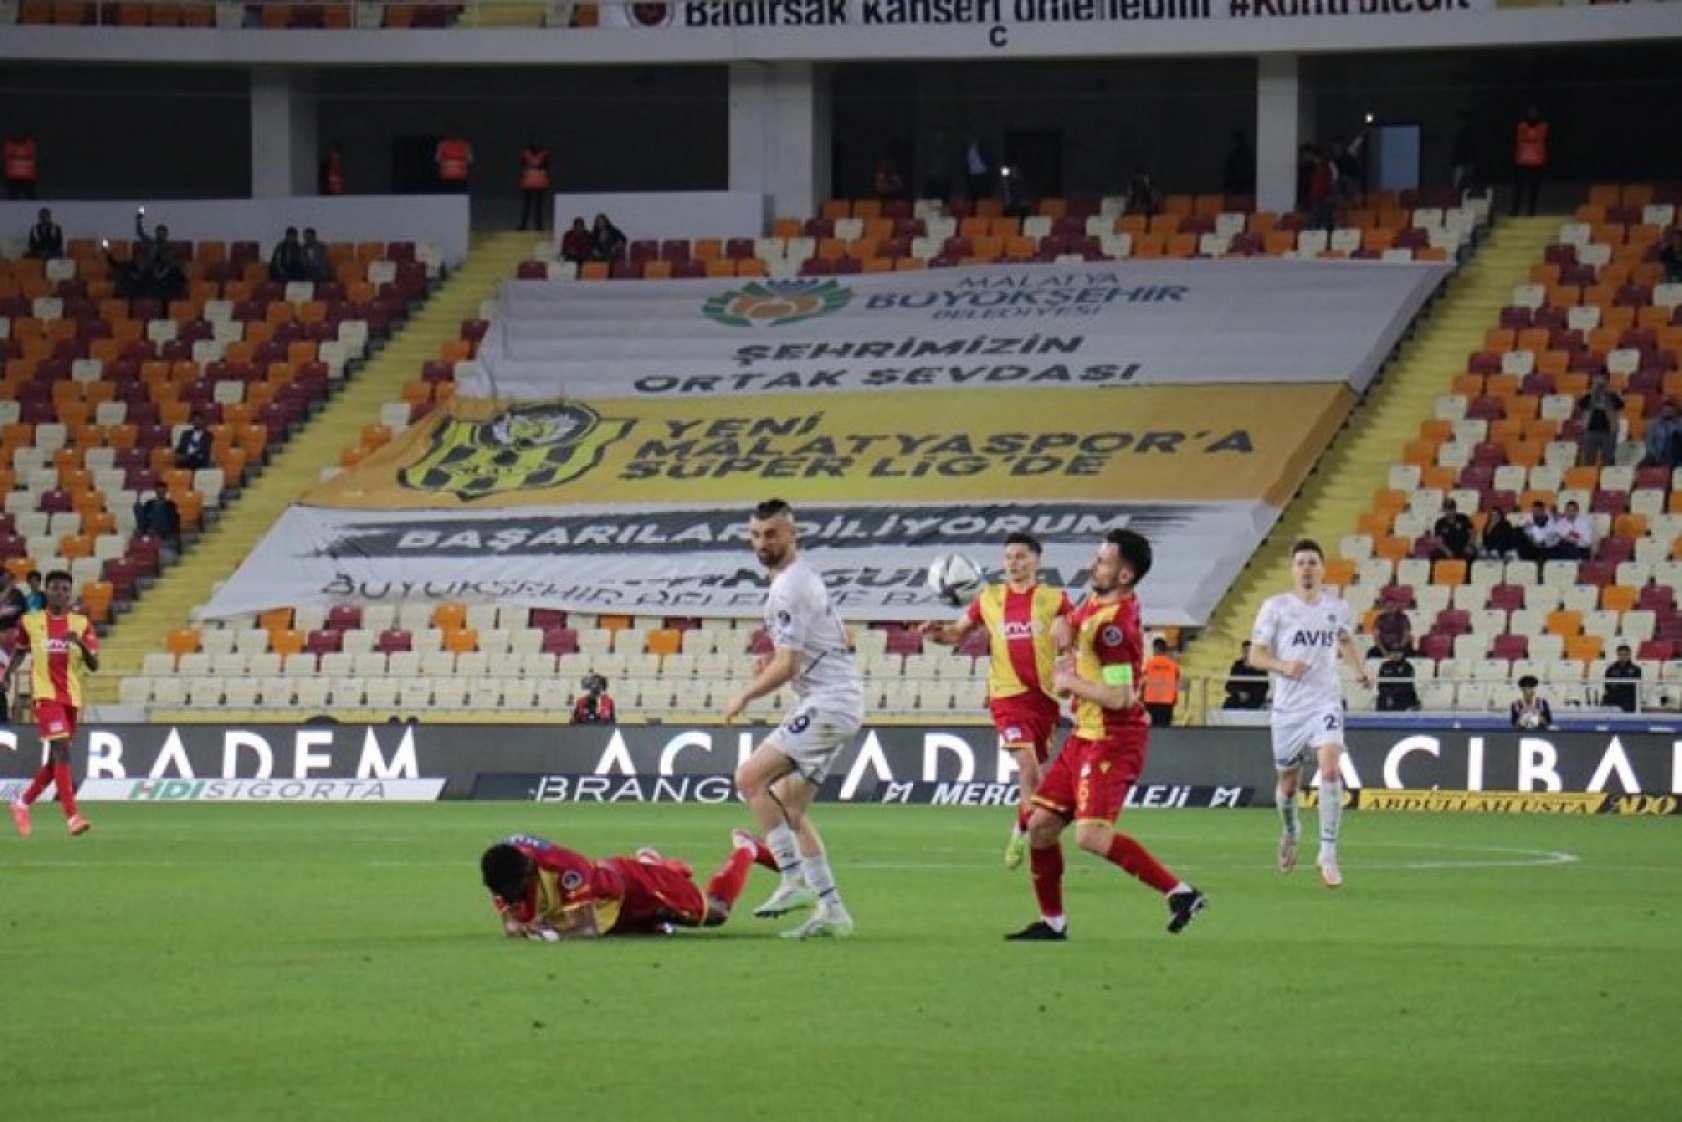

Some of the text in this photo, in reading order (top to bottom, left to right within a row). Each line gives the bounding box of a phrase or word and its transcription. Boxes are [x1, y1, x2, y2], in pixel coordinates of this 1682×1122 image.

[988, 25, 1009, 48] C
[634, 369, 849, 393] ORTAK
[1292, 629, 1335, 648] AVIS
[788, 714, 811, 734] 9
[931, 782, 1023, 805] MERC
